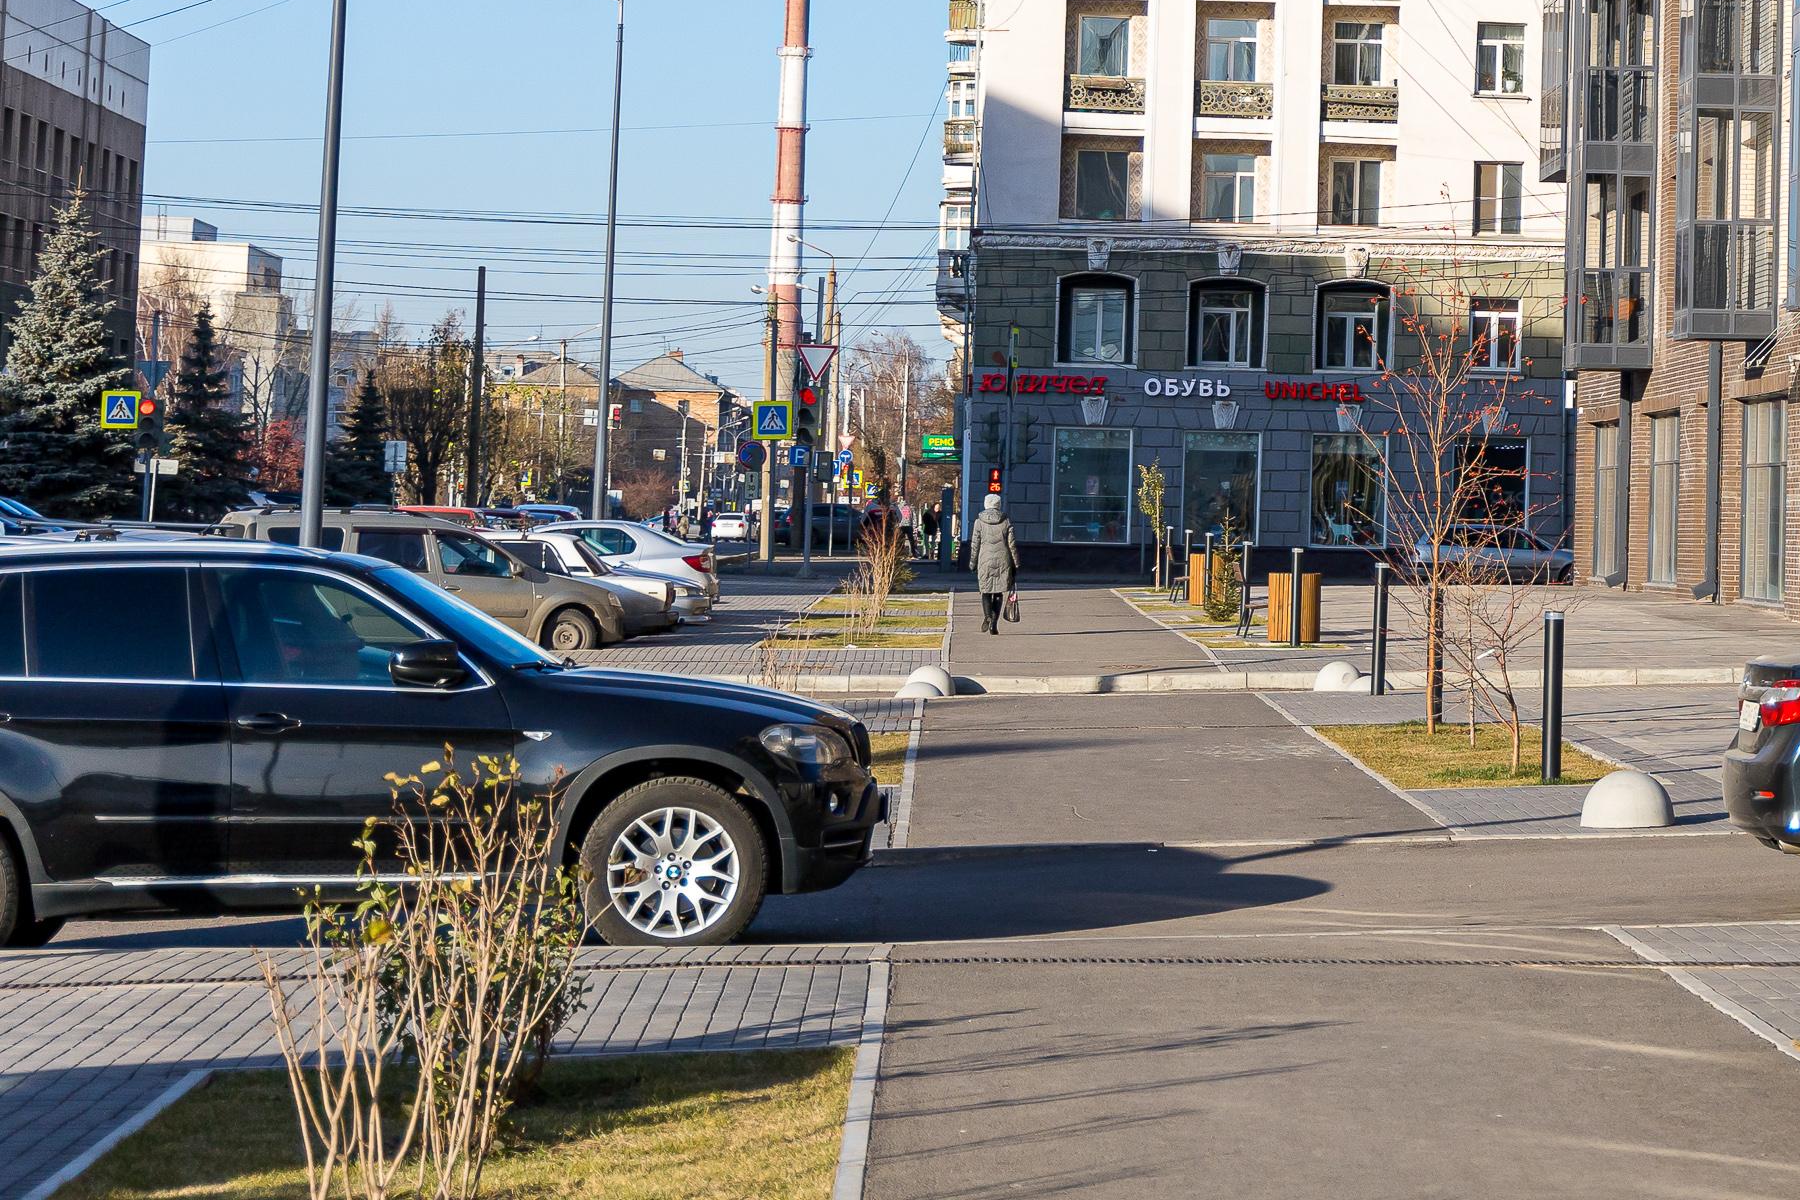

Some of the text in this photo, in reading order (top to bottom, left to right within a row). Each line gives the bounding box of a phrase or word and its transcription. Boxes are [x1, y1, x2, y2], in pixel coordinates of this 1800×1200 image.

[1144, 378, 1231, 397] ОБУВЬ
[1264, 380, 1365, 402] UNICHEL
[990, 482, 1001, 492] 26
